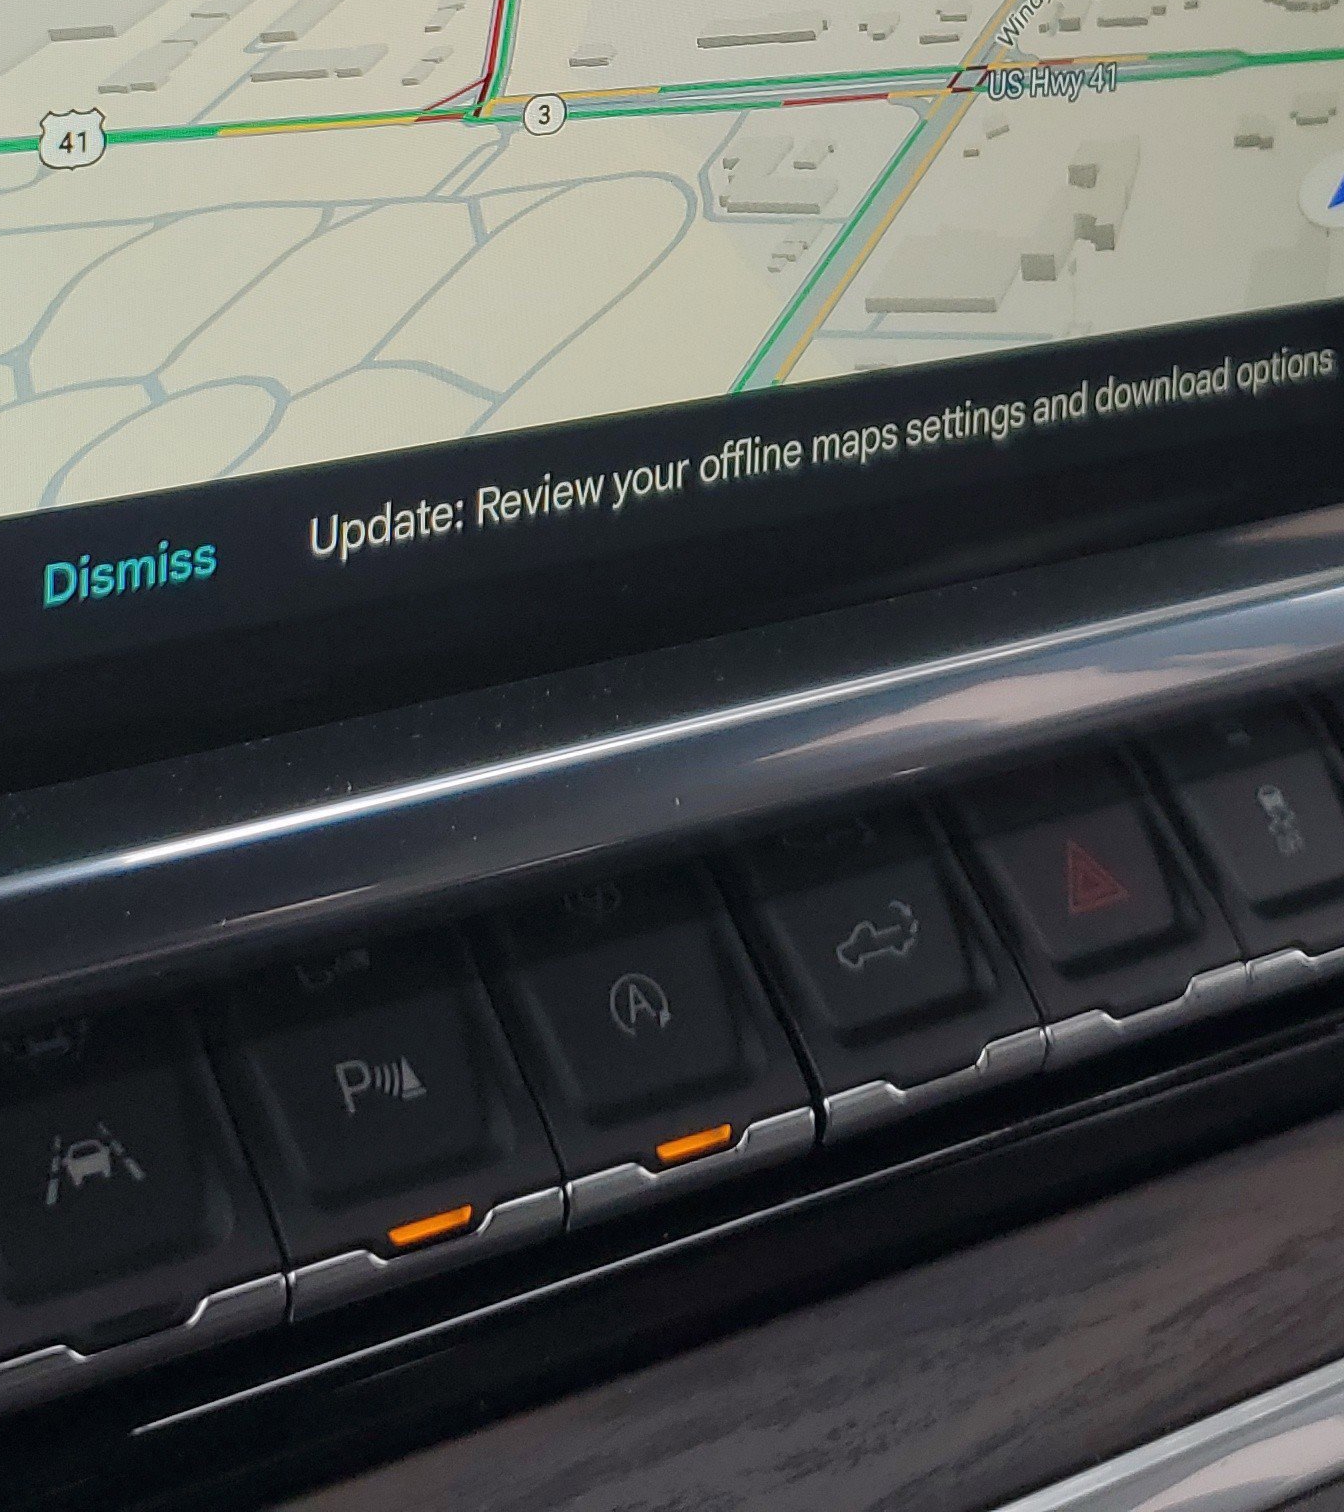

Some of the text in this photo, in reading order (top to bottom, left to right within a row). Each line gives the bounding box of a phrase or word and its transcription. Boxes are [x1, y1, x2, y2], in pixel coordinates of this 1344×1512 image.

[987, 63, 1120, 103] US Hwy 41
[537, 104, 552, 125] 3
[58, 129, 91, 154] 41
[309, 345, 1337, 565] Update: Review your offline maps settings and download options
[43, 538, 218, 610] Dismiss
